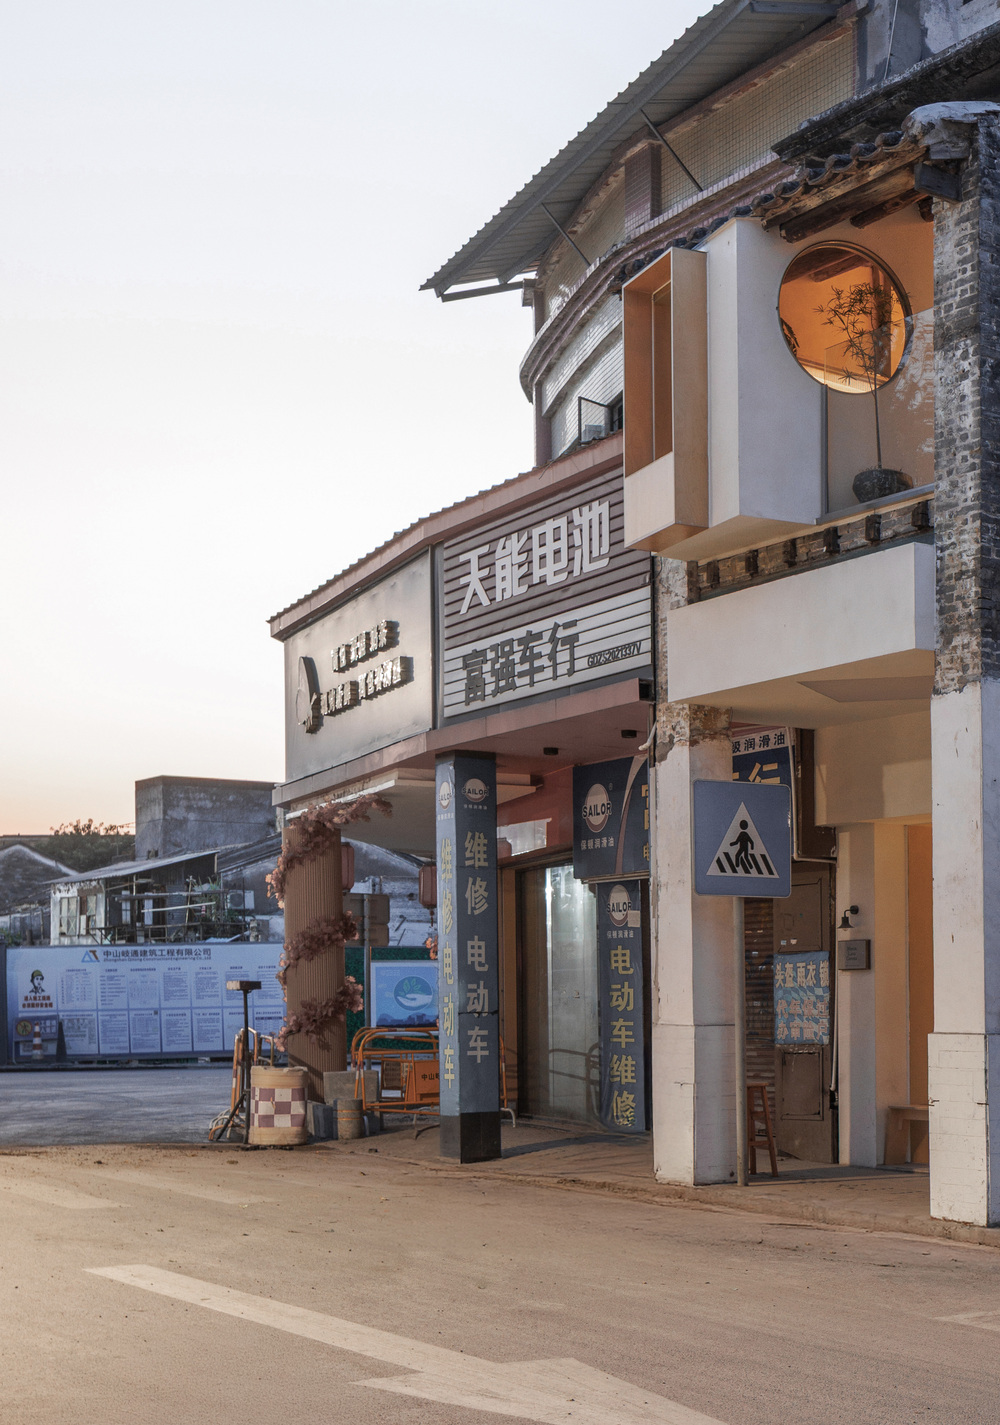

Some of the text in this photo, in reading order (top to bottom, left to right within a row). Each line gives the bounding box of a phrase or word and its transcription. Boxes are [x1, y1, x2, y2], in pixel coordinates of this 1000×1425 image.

[459, 500, 610, 615] 天能电池
[462, 619, 579, 706] 富强车行
[462, 787, 489, 796] SAILOR
[582, 802, 612, 818] SAILOR
[606, 901, 632, 913] SAILOR
[609, 945, 637, 1127] 电动车维修
